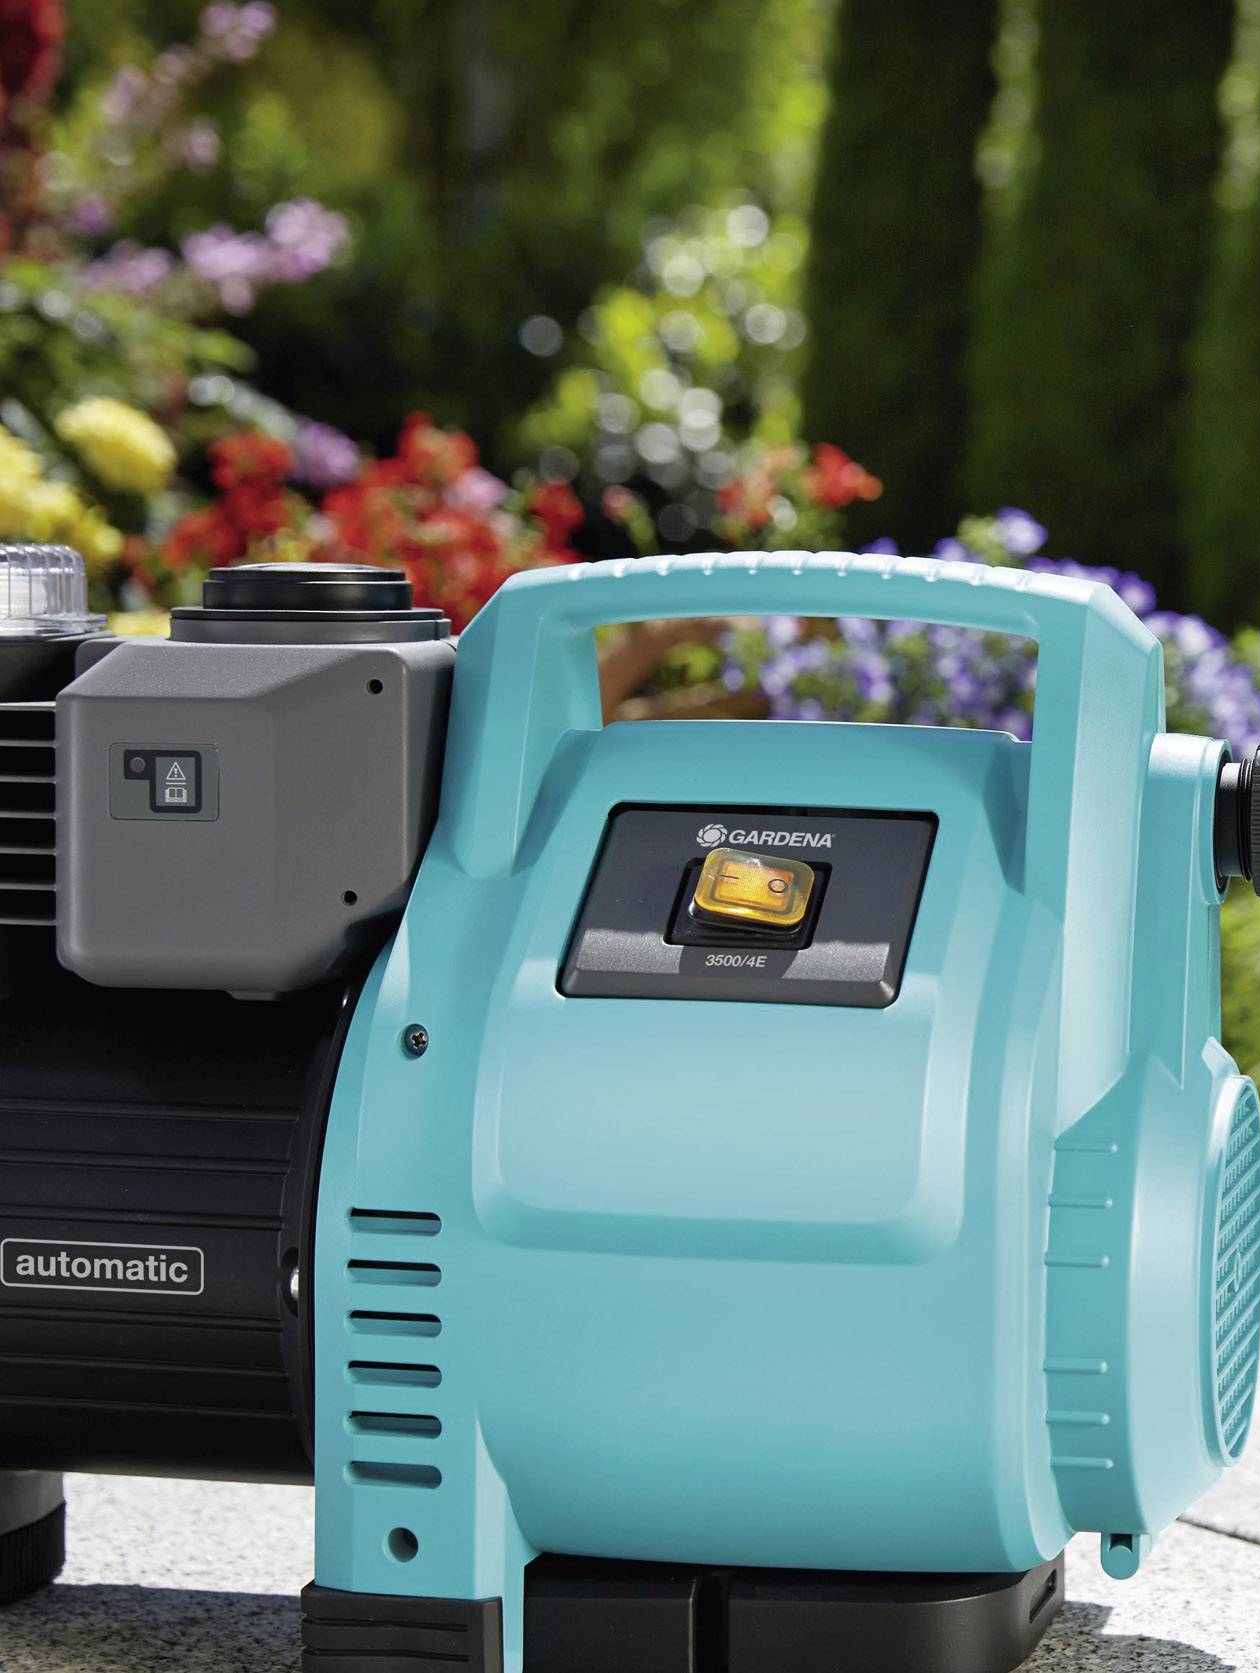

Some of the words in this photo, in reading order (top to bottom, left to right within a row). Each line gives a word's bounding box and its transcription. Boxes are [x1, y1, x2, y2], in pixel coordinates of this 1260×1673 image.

[728, 829, 833, 849] GARDENA
[705, 954, 767, 968] 3500/4E
[15, 1251, 189, 1284] automatic
